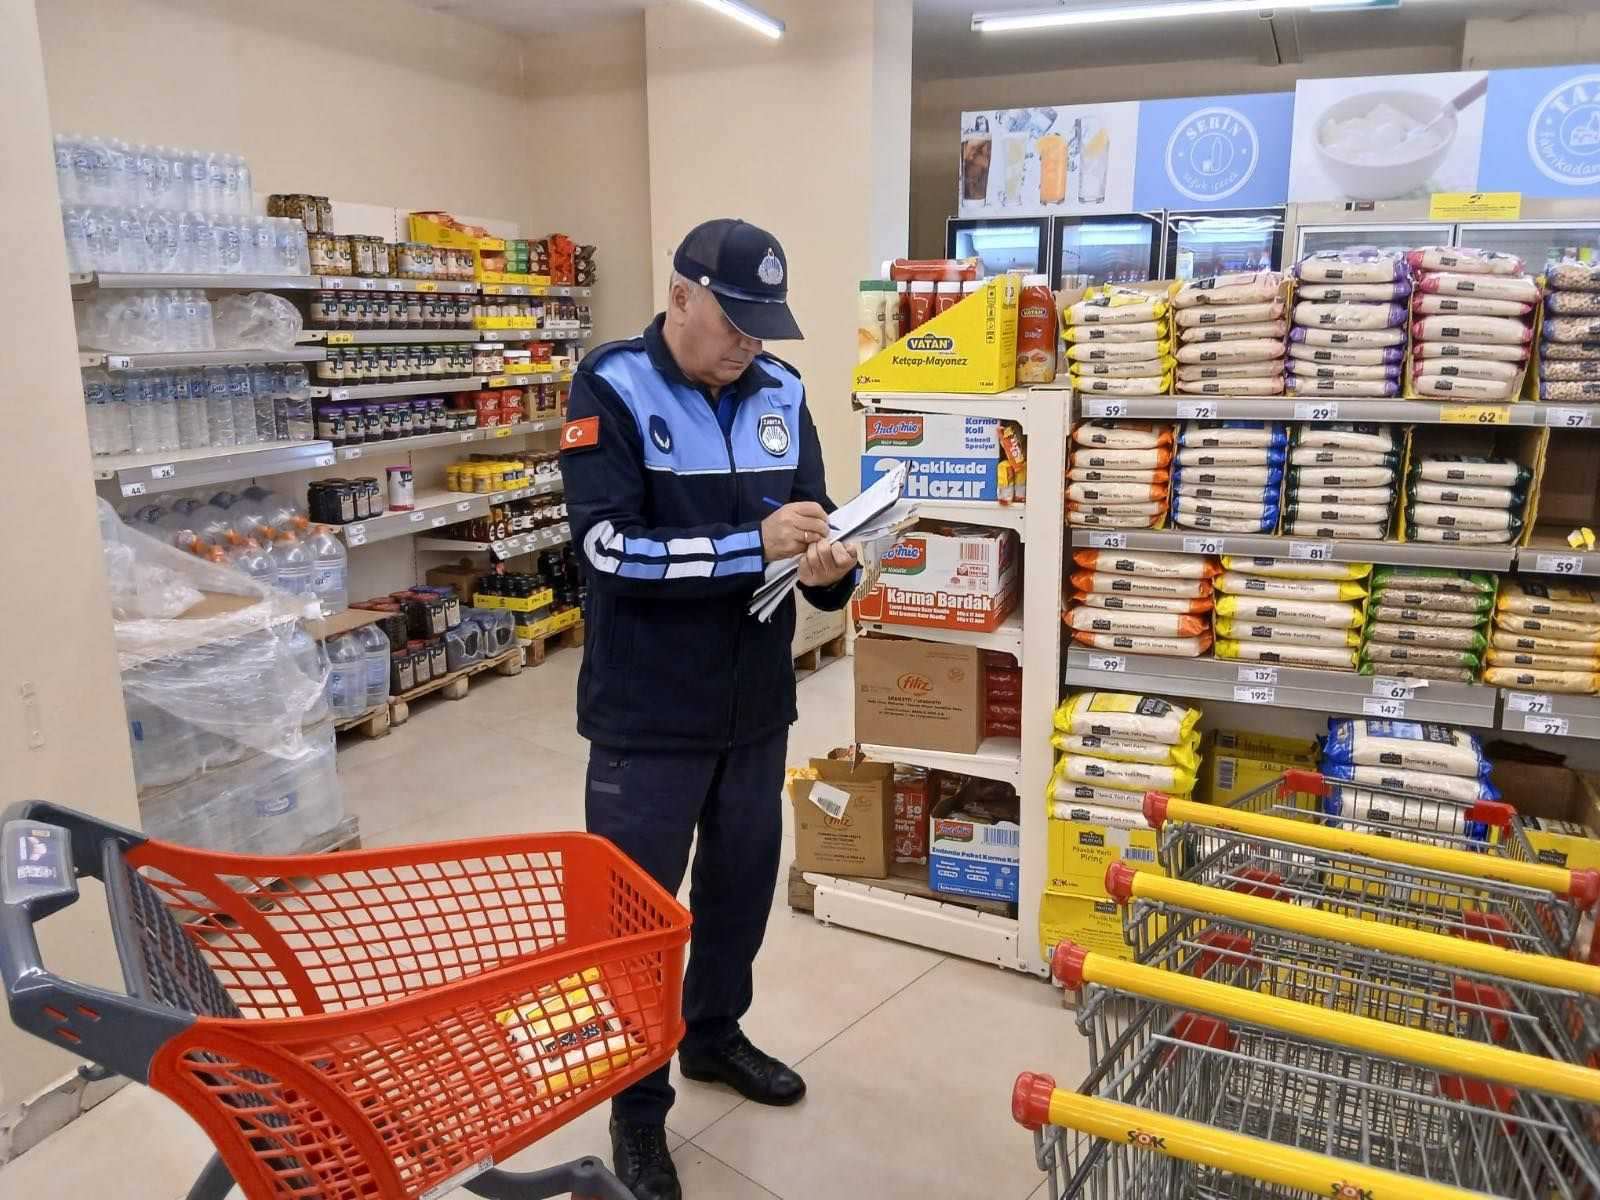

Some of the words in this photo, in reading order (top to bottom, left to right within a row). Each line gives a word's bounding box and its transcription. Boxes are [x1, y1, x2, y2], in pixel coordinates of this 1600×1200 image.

[910, 340, 946, 349] VATAN
[892, 356, 968, 367] Ketçap-Mayonez
[1105, 406, 1120, 416] 59
[1195, 408, 1209, 418] 72
[1312, 409, 1329, 419] 29
[965, 417, 998, 425] Karma
[1479, 412, 1496, 423] 62
[1567, 415, 1583, 426] 57
[874, 421, 918, 435] Indomie
[965, 426, 984, 434] Koli
[909, 460, 987, 474] Dakikada
[908, 475, 986, 498] Hazır
[1104, 537, 1119, 547] 43
[1200, 543, 1215, 553] 70
[1310, 549, 1323, 559] 81
[1555, 562, 1573, 573] 59
[887, 588, 935, 606] Karma
[937, 593, 992, 611] Bardak
[1103, 660, 1118, 670] 99
[1254, 672, 1270, 681] 137
[902, 675, 930, 691] filiz
[1250, 691, 1266, 700] 192
[1391, 688, 1406, 698] 67
[1380, 705, 1397, 715] 147
[1528, 702, 1544, 713] 27
[1544, 725, 1560, 735] 27
